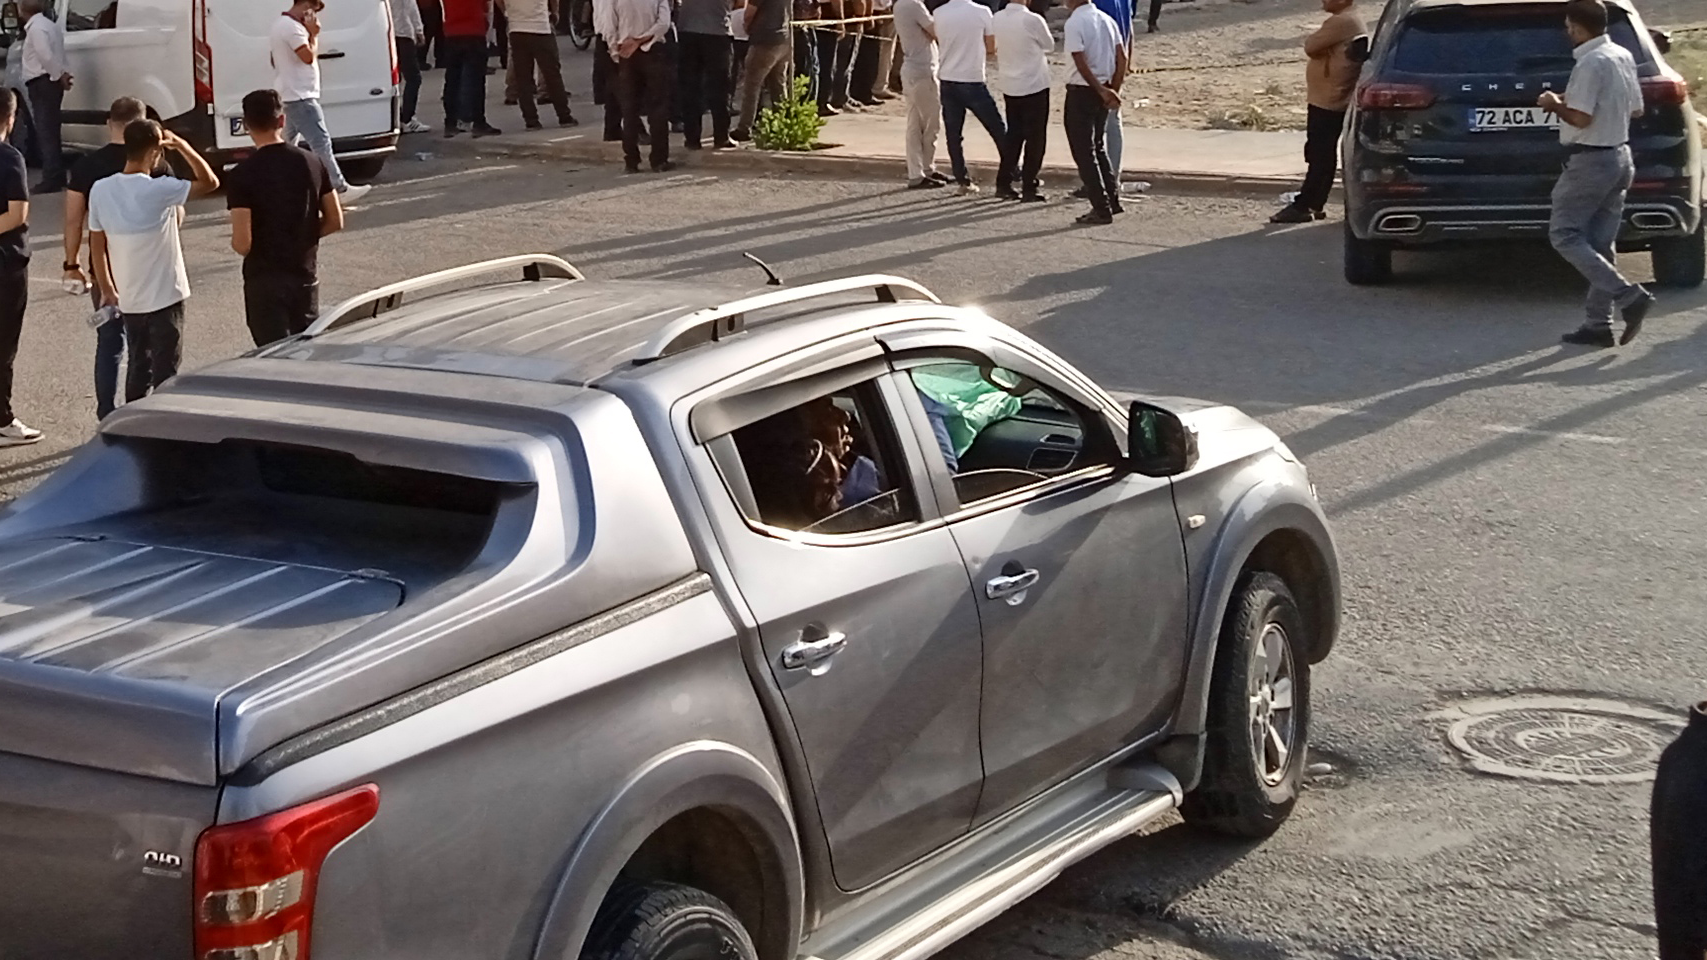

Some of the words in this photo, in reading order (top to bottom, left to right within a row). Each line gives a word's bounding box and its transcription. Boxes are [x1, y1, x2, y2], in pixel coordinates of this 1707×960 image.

[1461, 82, 1552, 91] CHER
[1476, 110, 1496, 125] 72
[1502, 109, 1535, 125] ACA
